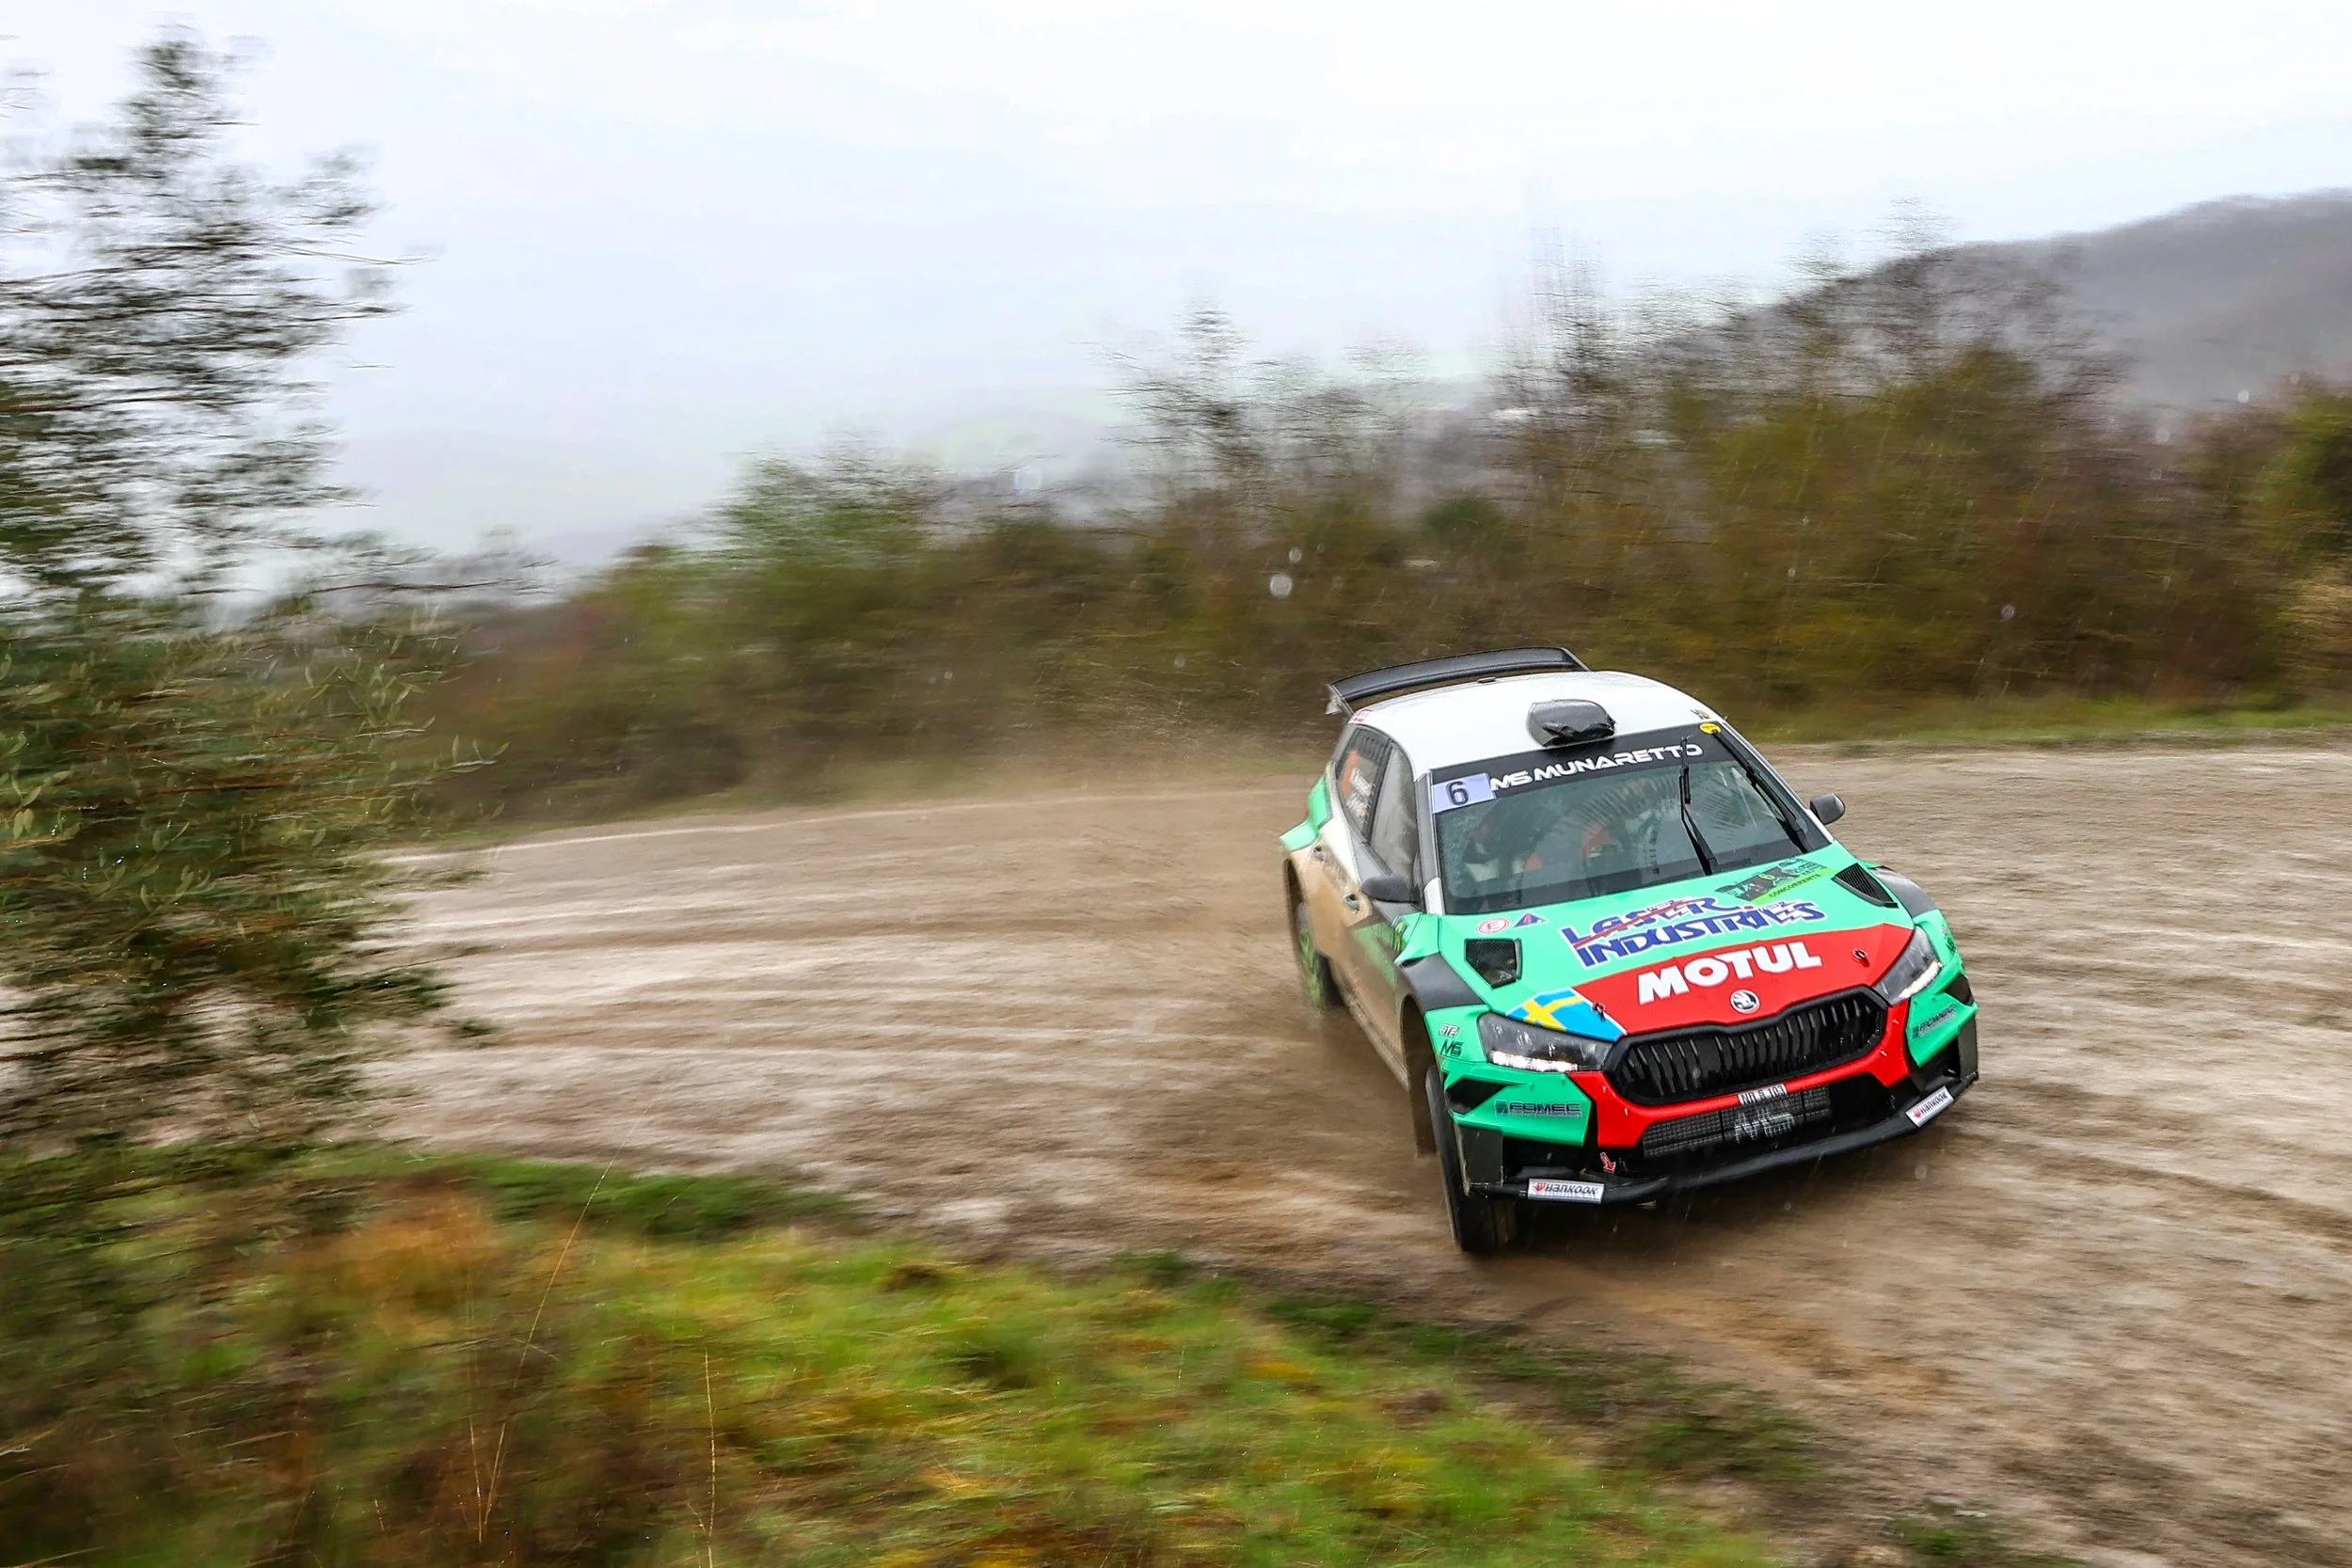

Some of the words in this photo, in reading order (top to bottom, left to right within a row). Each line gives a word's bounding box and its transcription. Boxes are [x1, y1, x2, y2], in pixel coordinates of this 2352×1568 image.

[1490, 770, 1533, 791] MS
[1534, 744, 1704, 782] MUNARETTO
[1446, 780, 1470, 807] 6
[1757, 872, 1776, 880] 6
[1562, 897, 1741, 944] LASER
[1576, 901, 1826, 968] INDUSTRIES
[1637, 942, 1823, 1005] MOTUL
